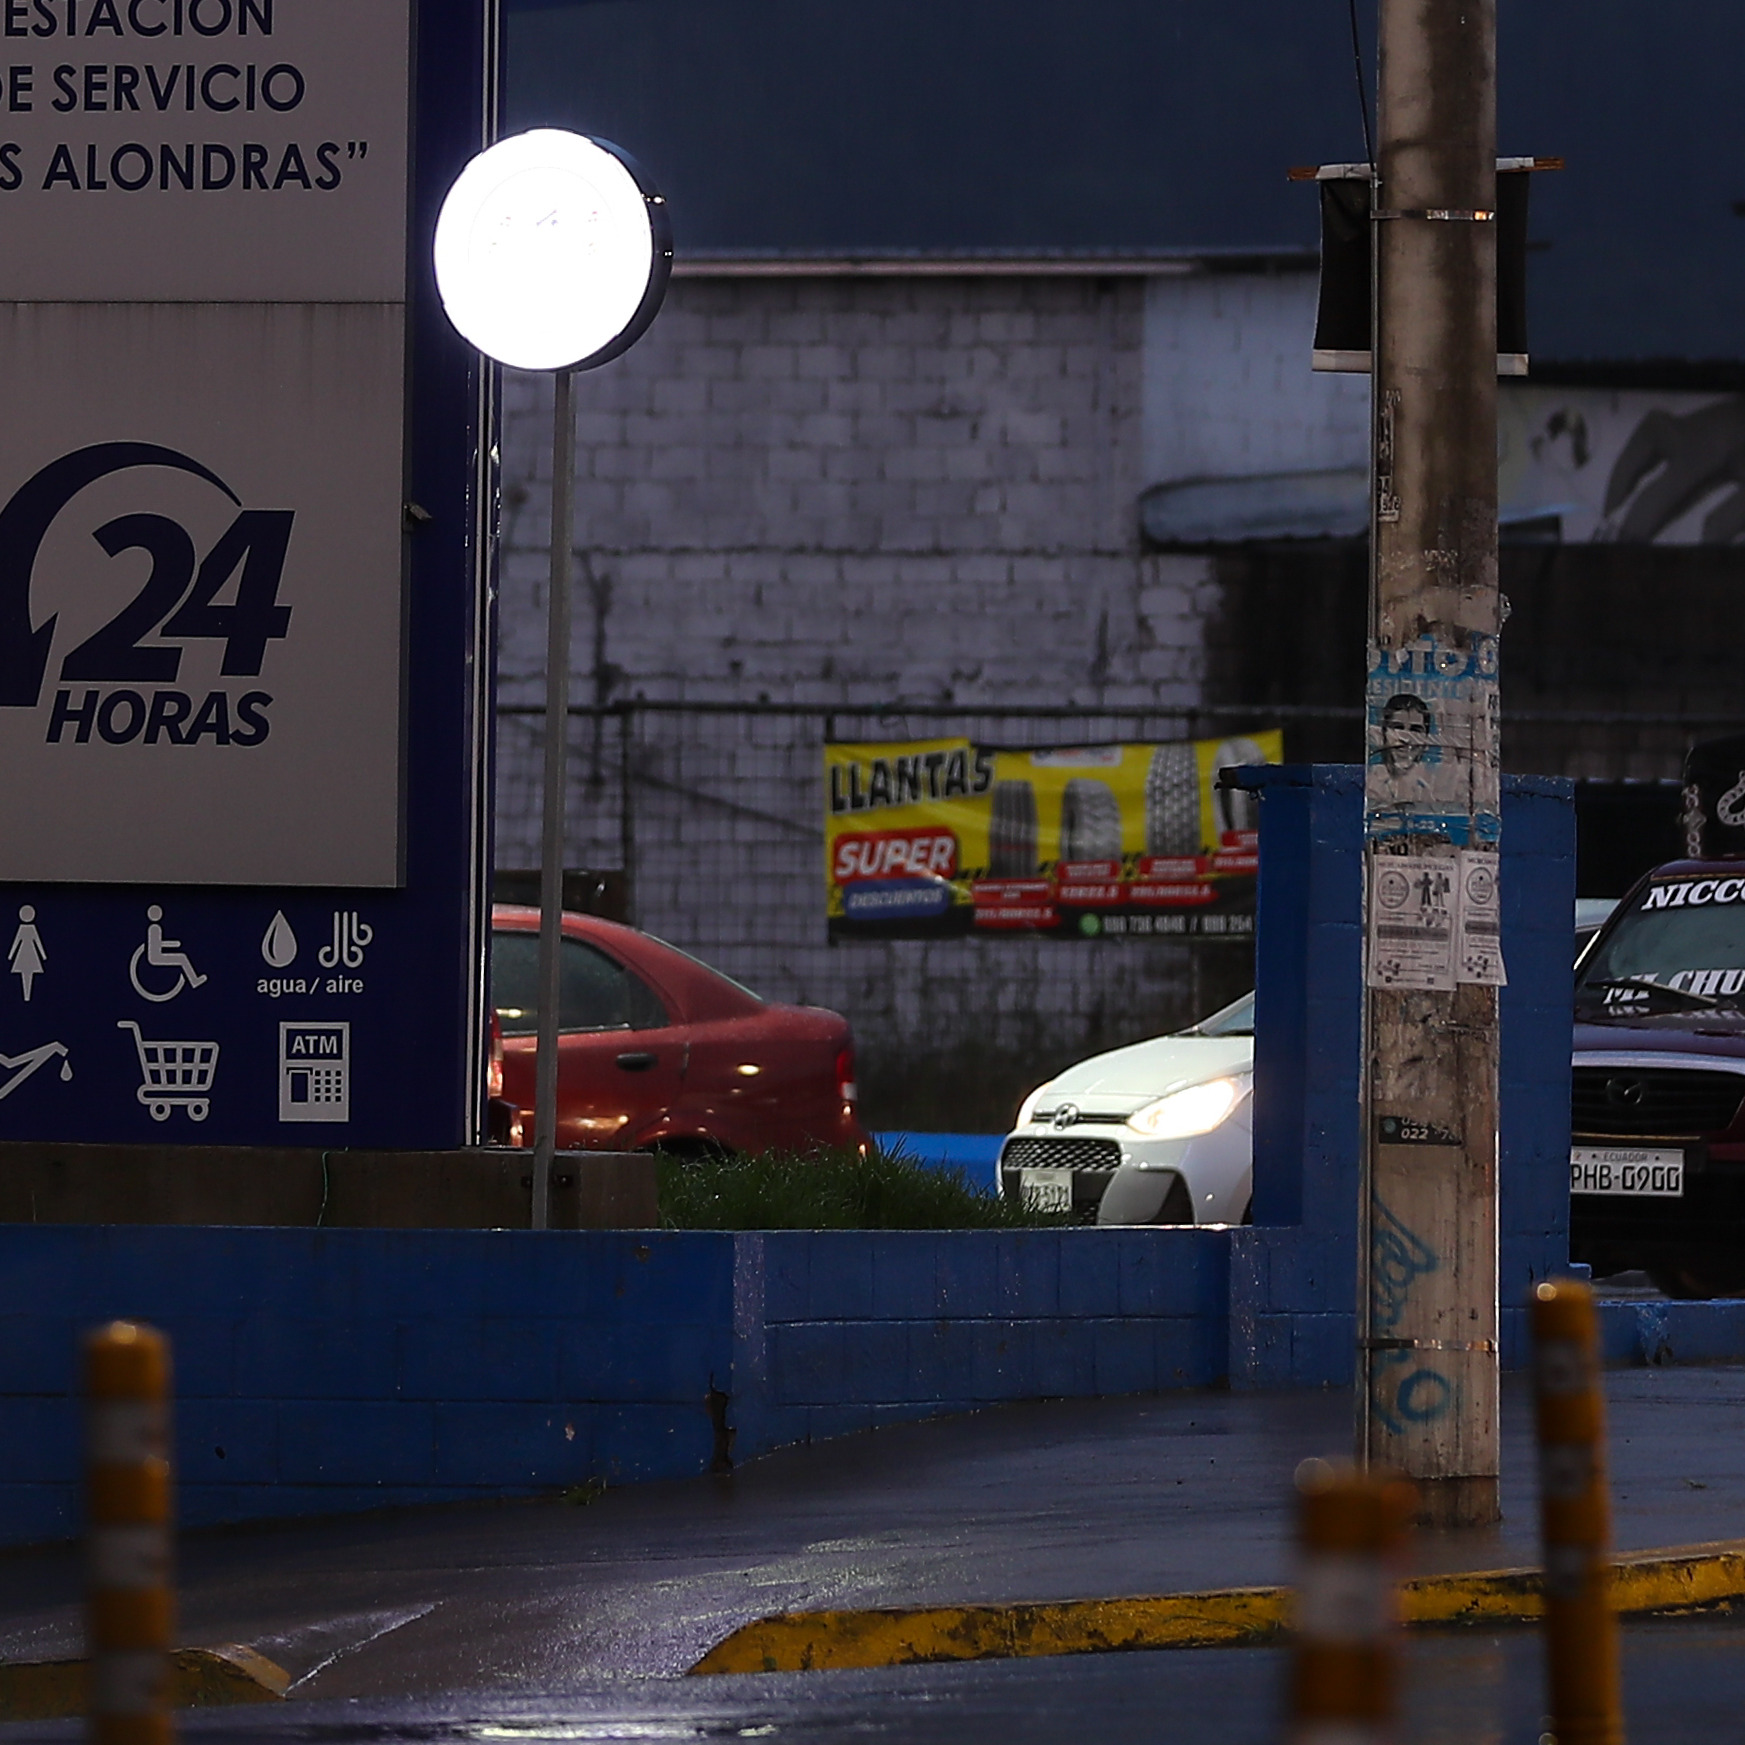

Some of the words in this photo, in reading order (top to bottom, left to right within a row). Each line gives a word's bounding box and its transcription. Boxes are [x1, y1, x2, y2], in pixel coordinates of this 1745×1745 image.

[51, 62, 306, 113] SERVICIO
[59, 509, 296, 683] 24
[45, 688, 274, 746] HORAS
[831, 747, 996, 815] LLANTAS
[835, 836, 956, 878] SUPER
[325, 975, 365, 995] aire
[291, 1034, 339, 1056] ATM
[1604, 1152, 1649, 1162] ECUADOR
